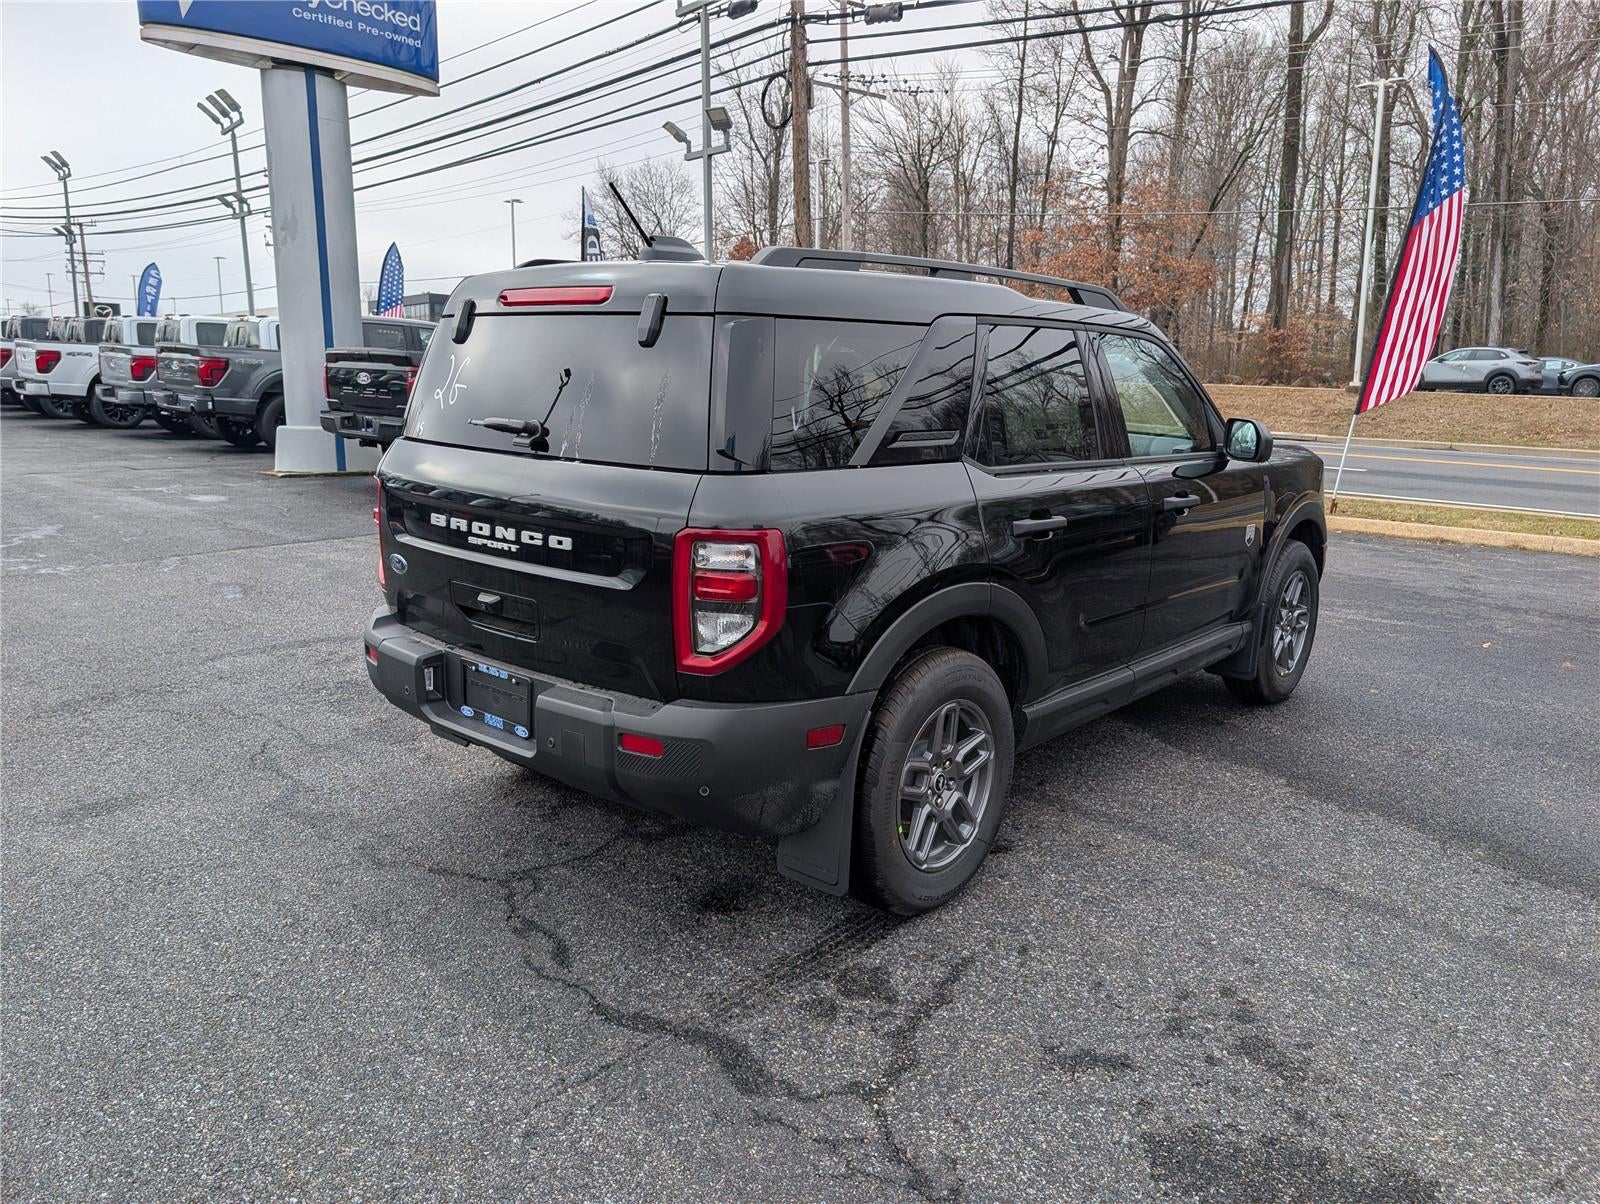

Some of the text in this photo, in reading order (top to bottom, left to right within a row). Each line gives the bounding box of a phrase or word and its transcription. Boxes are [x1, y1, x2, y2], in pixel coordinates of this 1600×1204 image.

[292, 7, 422, 49] Certified Pre-owned
[429, 512, 573, 551] BRONCO
[467, 535, 520, 553] SPORT
